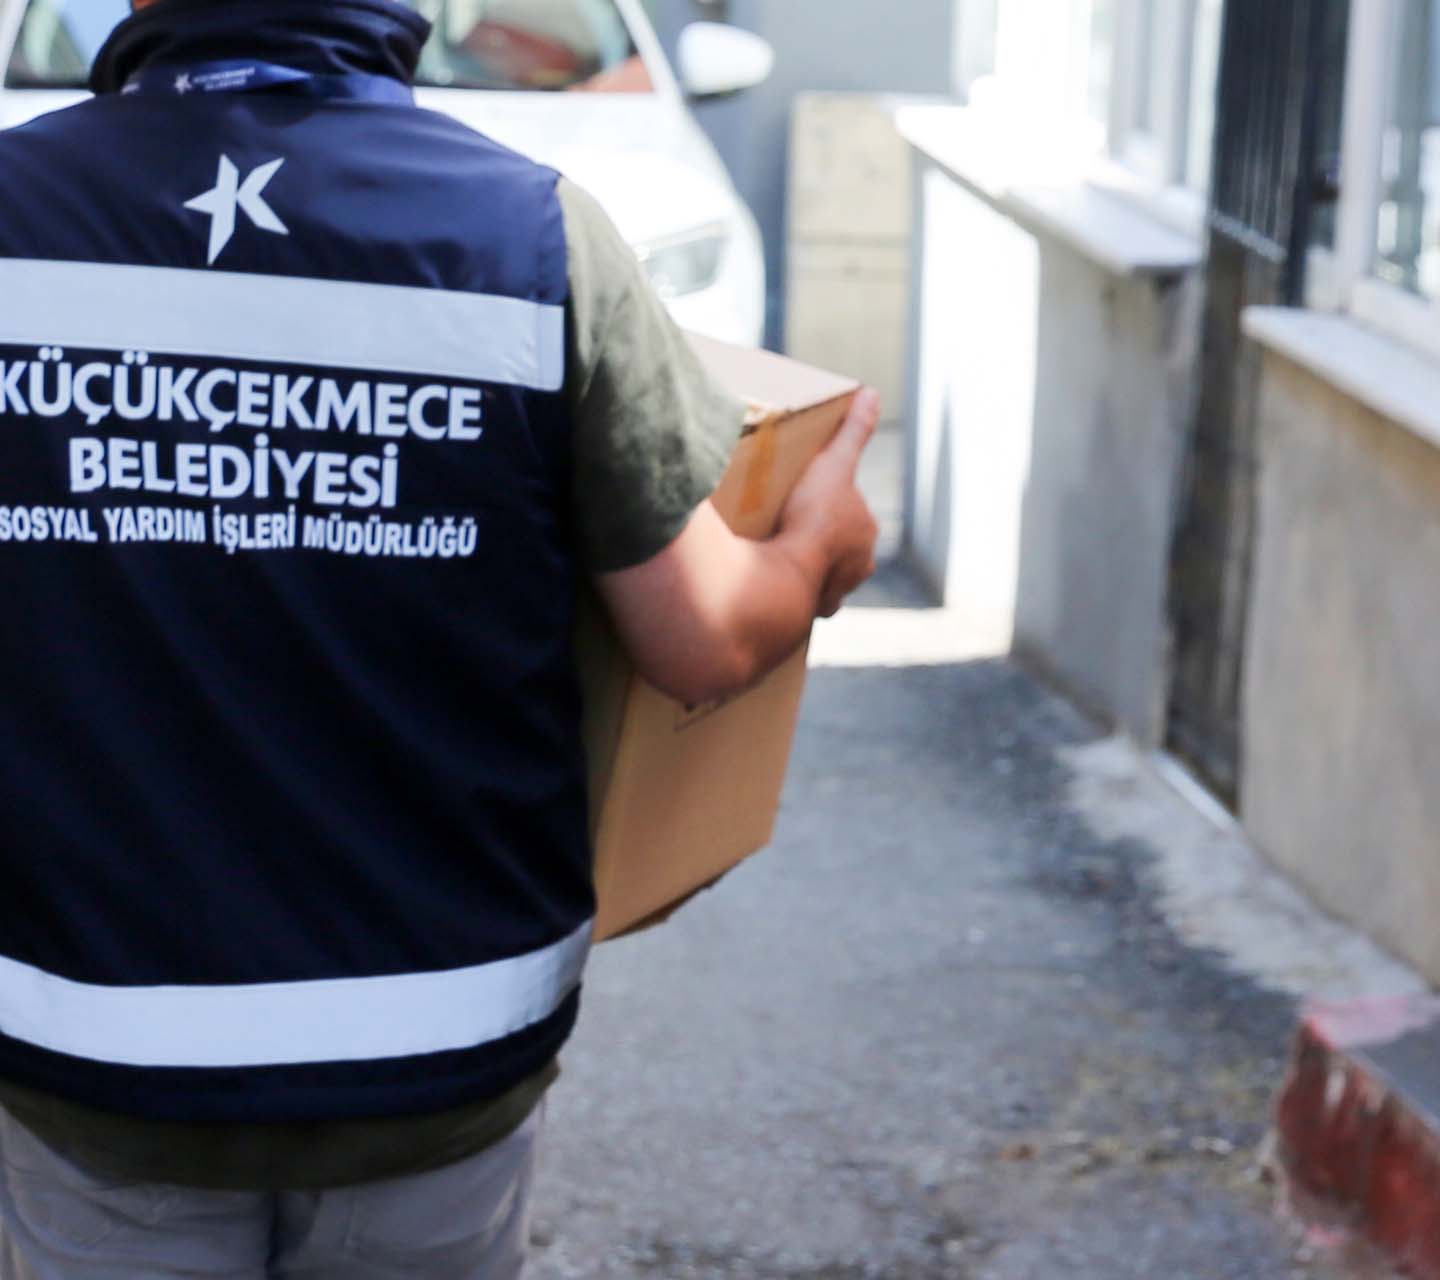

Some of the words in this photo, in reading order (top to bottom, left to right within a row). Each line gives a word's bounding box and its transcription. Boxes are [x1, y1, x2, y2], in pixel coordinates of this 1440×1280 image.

[69, 433, 398, 509] BELEDİYESİ
[103, 507, 206, 543] YARDIM
[213, 504, 296, 554] İŞLERİ
[302, 513, 478, 557] MÜDÜRLÜĞÜ
